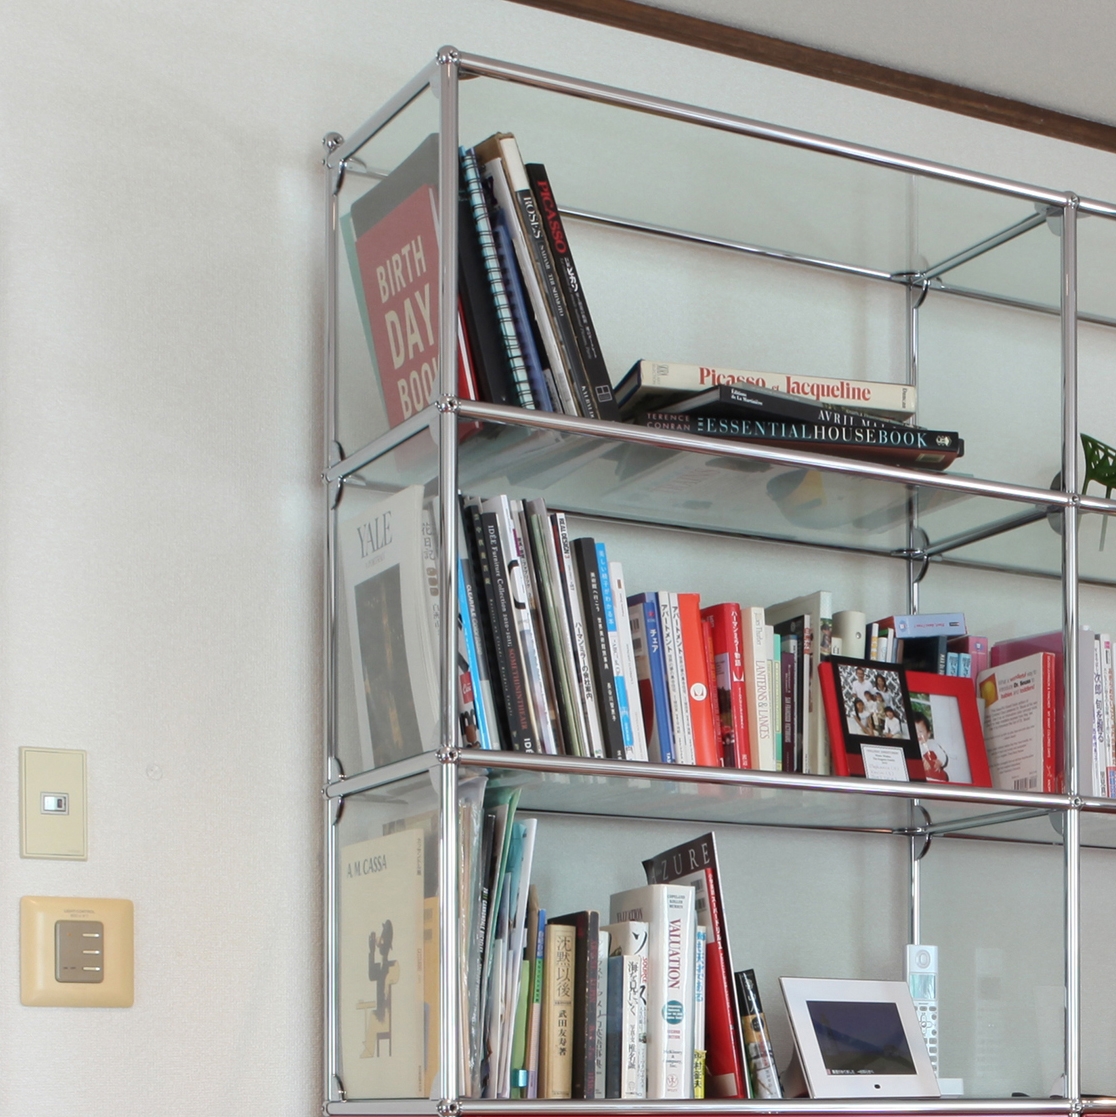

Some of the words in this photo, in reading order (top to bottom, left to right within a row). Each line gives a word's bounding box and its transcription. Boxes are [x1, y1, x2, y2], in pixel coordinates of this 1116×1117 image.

[537, 181, 567, 254] PICASSO
[376, 235, 428, 304] BIRTH
[384, 283, 436, 370] DAY
[397, 357, 439, 421] BOO
[700, 367, 766, 388] Picasso
[786, 376, 872, 402] Jacqueline
[647, 413, 690, 422] TERENCE
[647, 422, 690, 431] CONRAN
[357, 511, 392, 559] YALE
[492, 546, 502, 577] Furniture
[497, 578, 507, 612] Collection
[650, 629, 659, 653] チェア
[756, 660, 768, 700] LANTERNS
[523, 737, 535, 754] IDÉ
[758, 708, 770, 739] LANCES
[362, 854, 387, 875] CASSA
[556, 936, 572, 997] 沈黙以後
[668, 919, 681, 989] VALUATION
